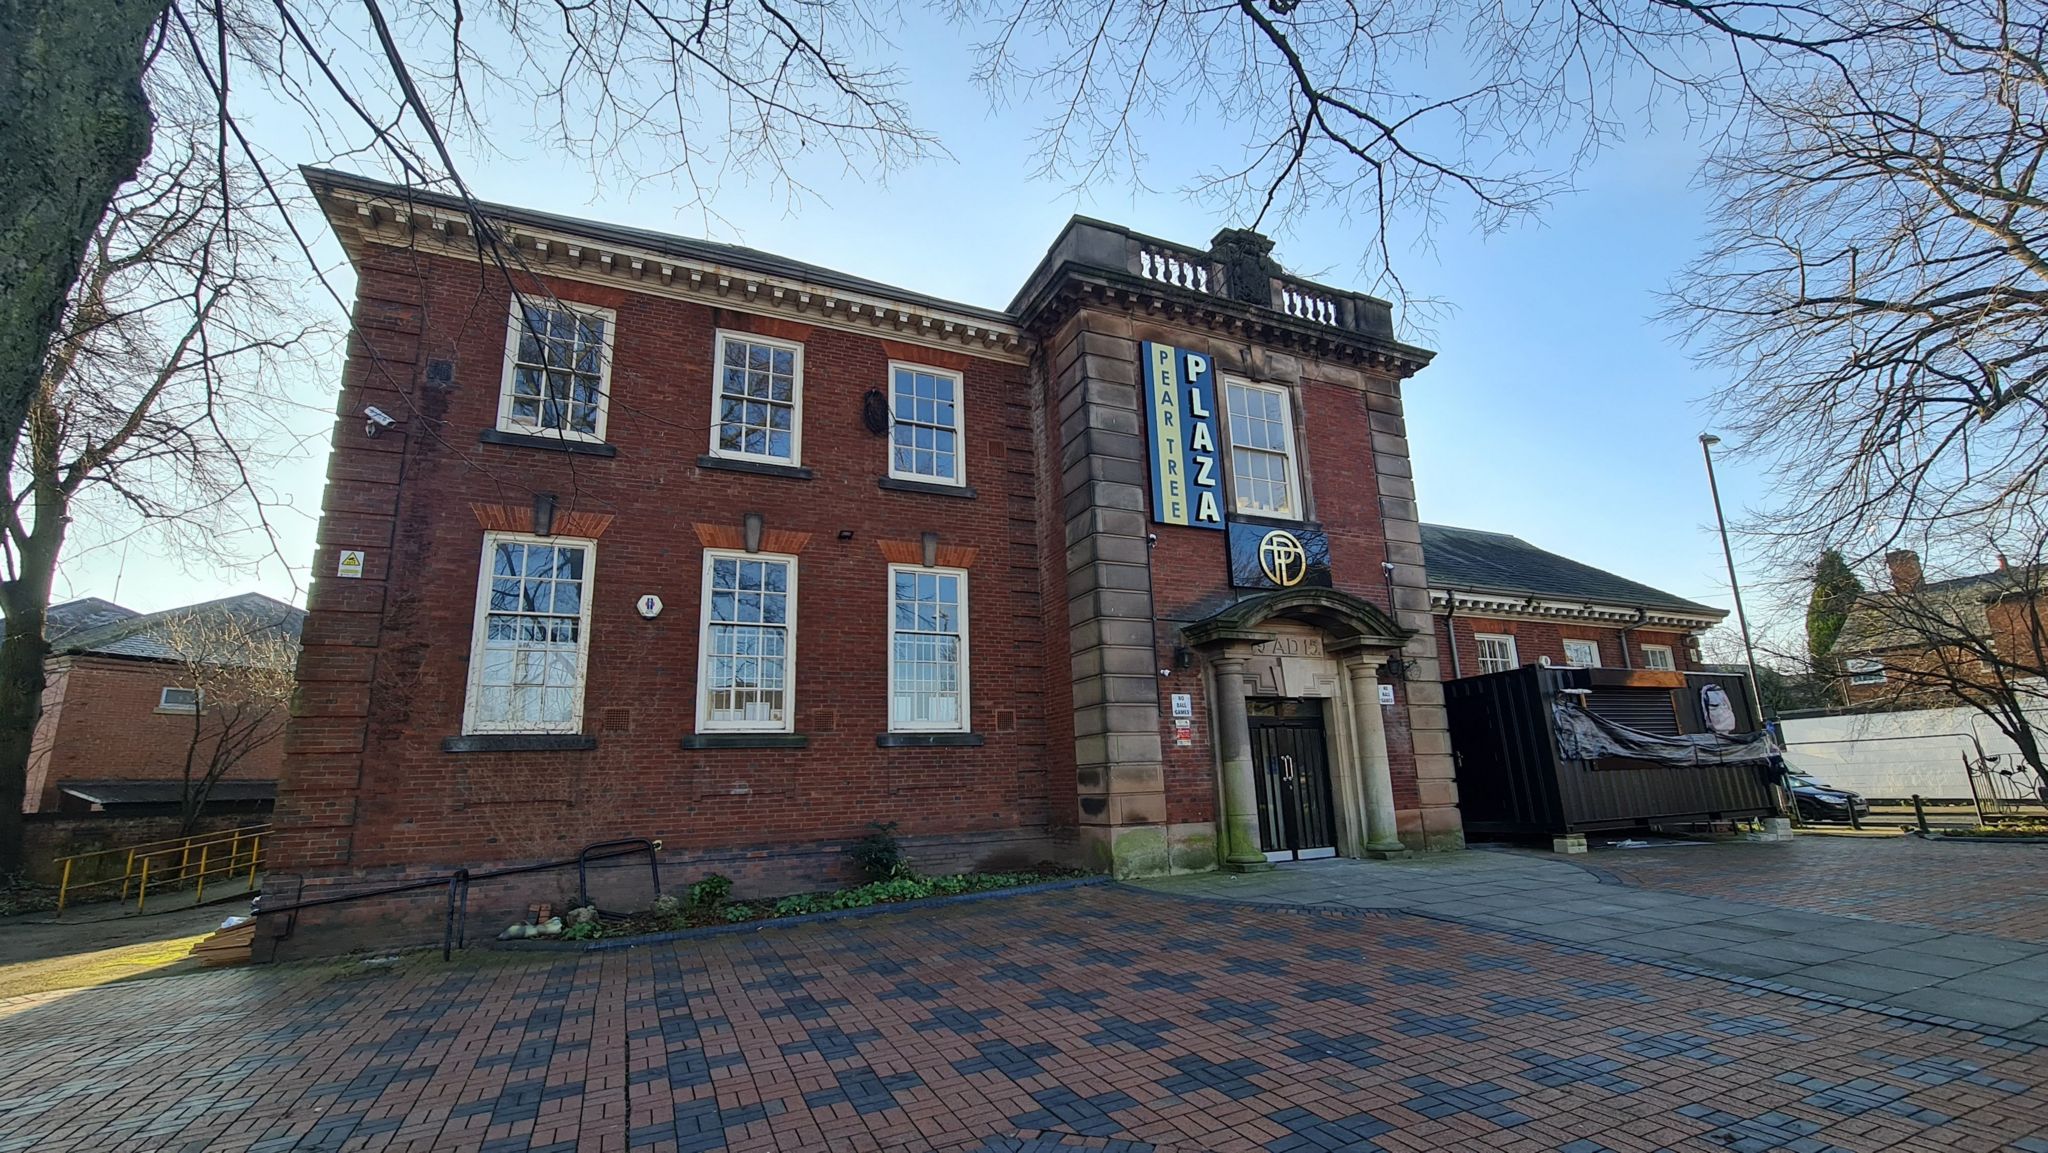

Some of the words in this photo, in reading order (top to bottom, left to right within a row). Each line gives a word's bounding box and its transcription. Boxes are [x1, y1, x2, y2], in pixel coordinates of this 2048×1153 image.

[1160, 350, 1174, 427] PEAR
[1186, 353, 1221, 522] PLAZA
[1166, 438, 1181, 519] TREE
[1272, 637, 1298, 655] AD
